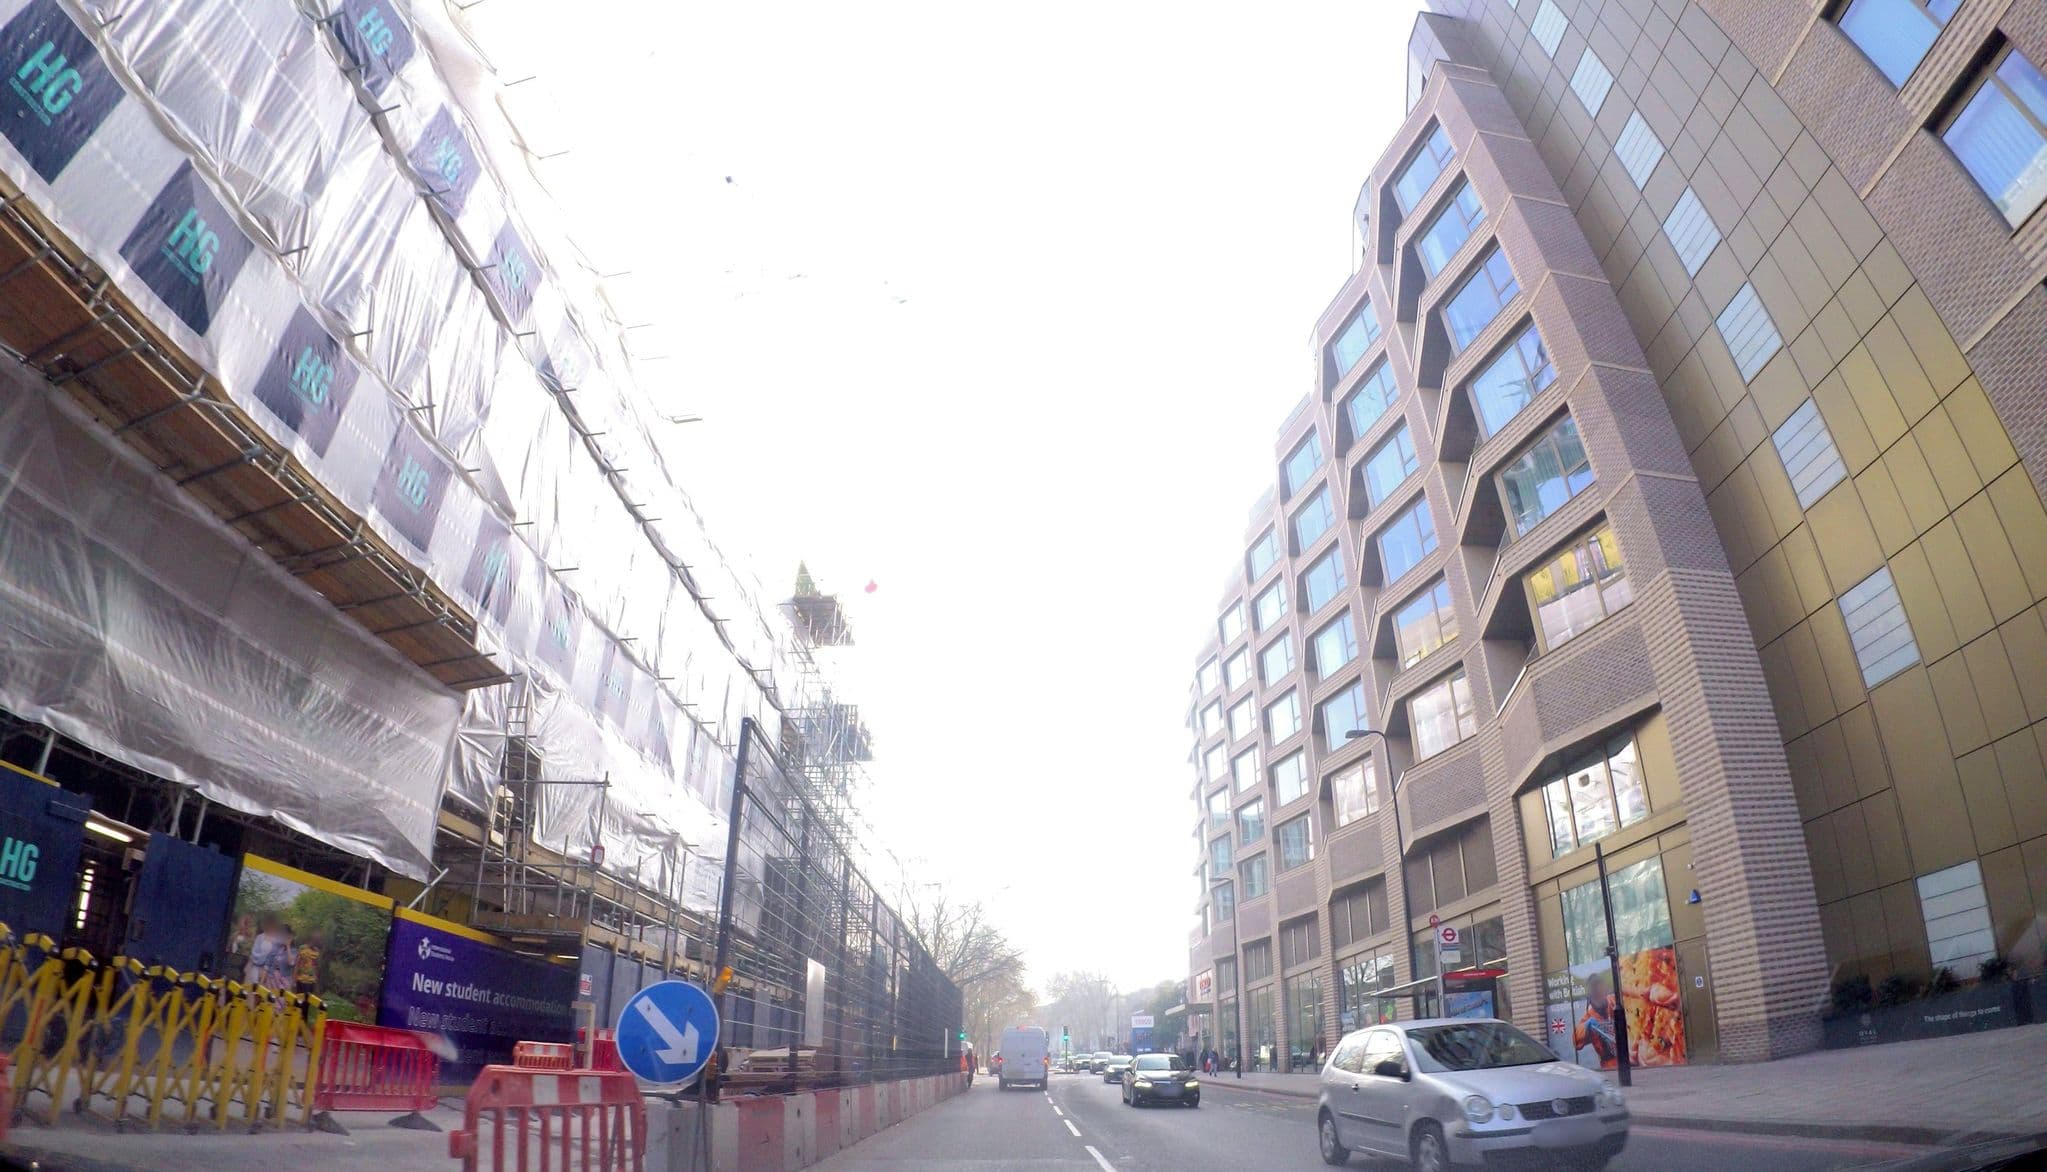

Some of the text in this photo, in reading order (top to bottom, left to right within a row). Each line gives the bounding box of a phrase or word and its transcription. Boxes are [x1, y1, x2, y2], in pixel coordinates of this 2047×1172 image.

[356, 6, 393, 56] HG
[16, 41, 82, 113] HG
[168, 207, 219, 273] HG
[292, 346, 334, 404] HG
[0, 836, 39, 881] HG
[412, 972, 443, 996] New
[445, 981, 490, 1004] student
